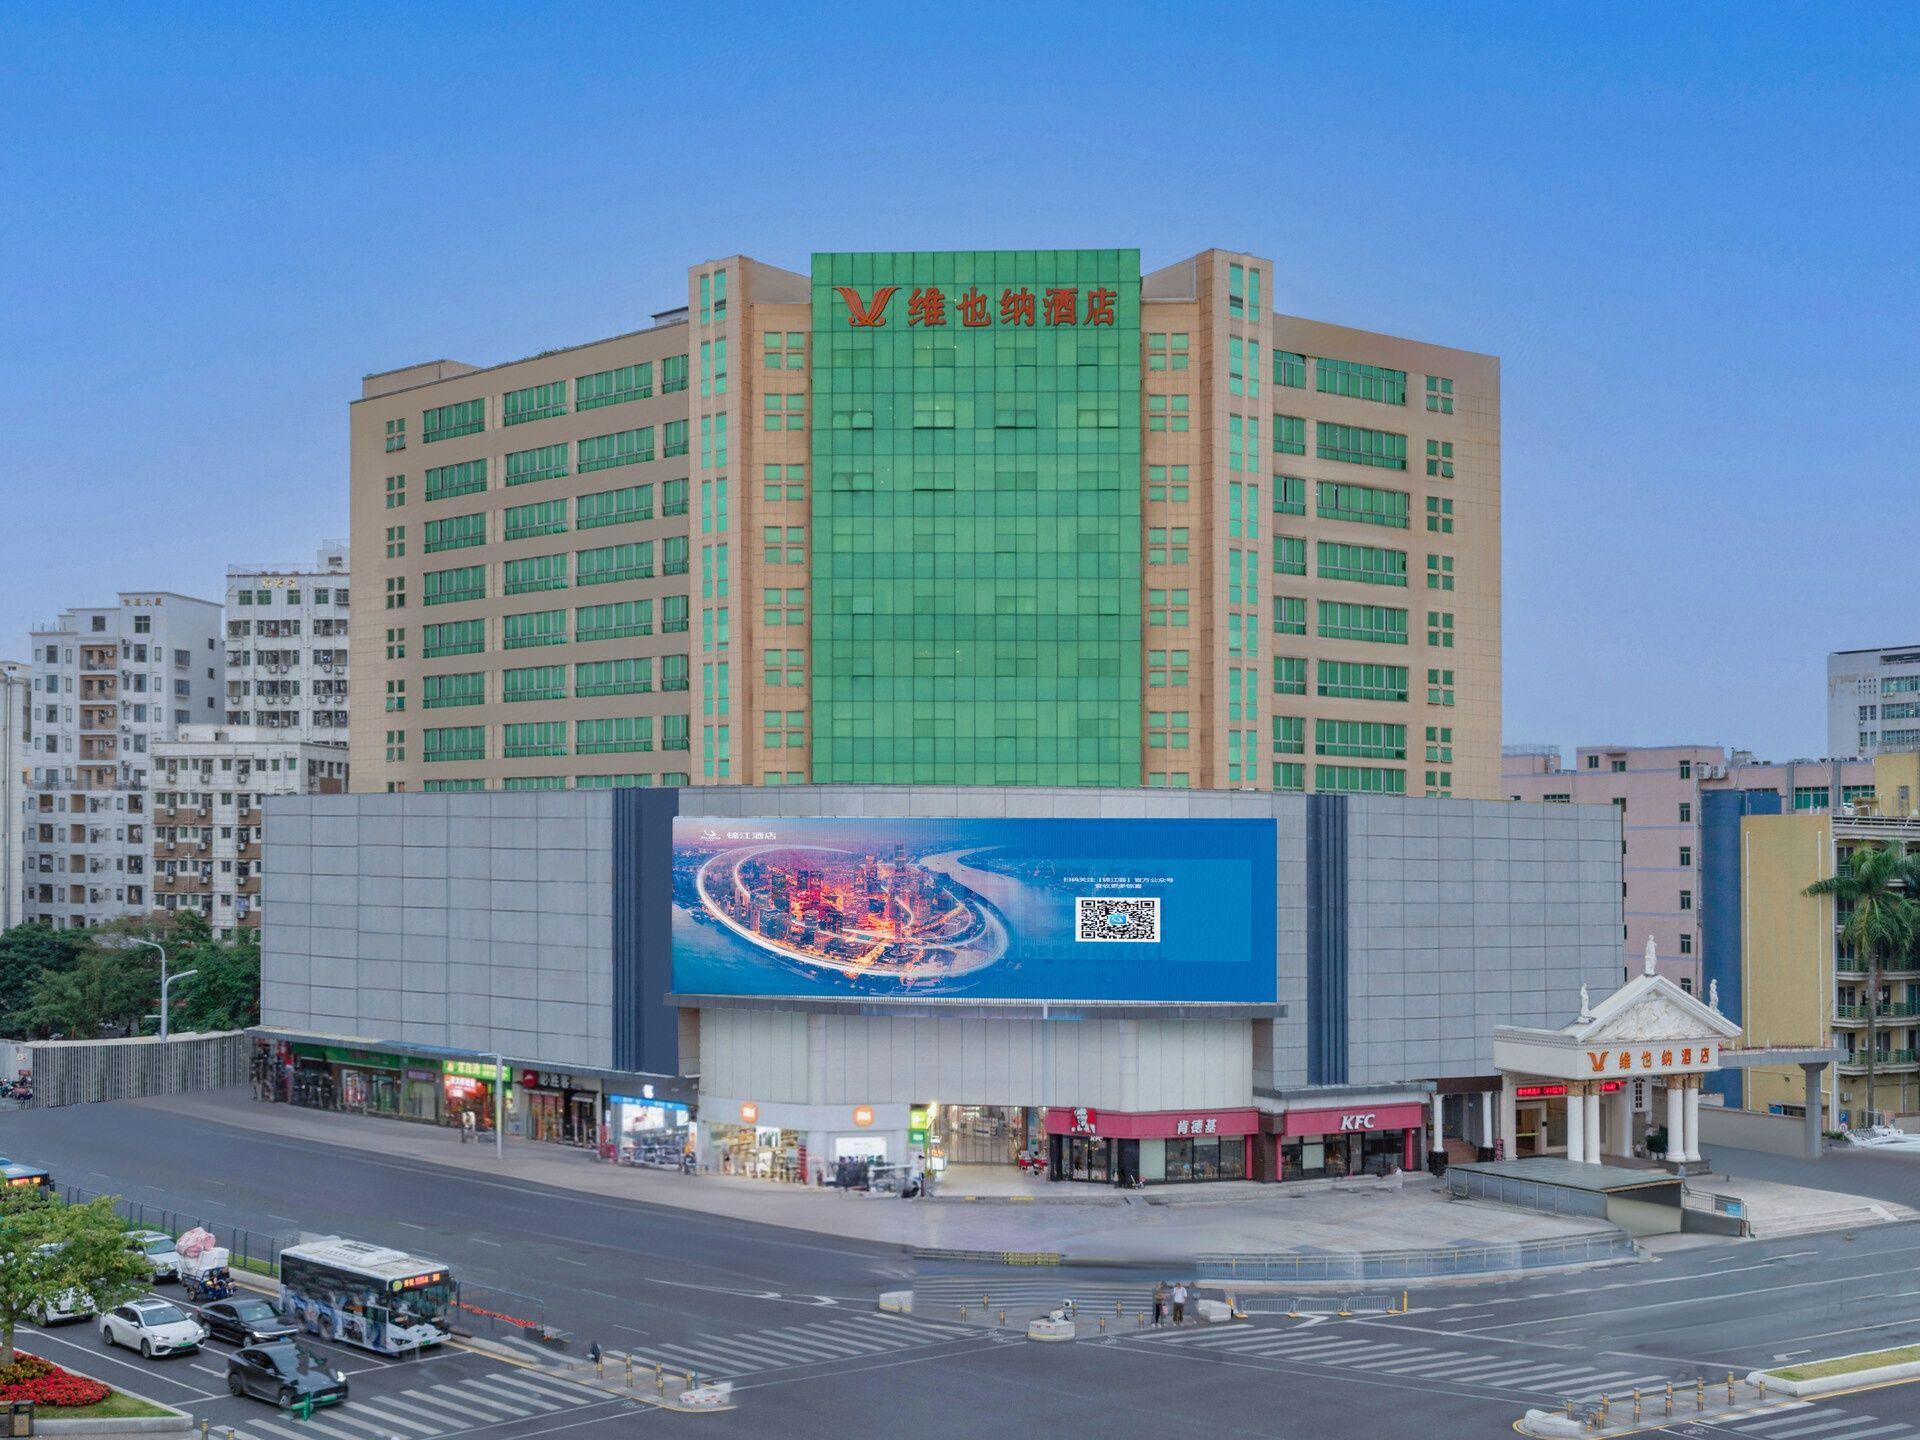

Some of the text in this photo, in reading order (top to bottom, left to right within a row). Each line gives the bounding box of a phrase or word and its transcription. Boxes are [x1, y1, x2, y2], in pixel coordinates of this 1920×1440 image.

[907, 286, 1118, 327] 维也纳酒店
[726, 831, 777, 840] 锦江酒店
[1618, 1047, 1710, 1070] 维也纳酒店
[539, 1072, 570, 1089] 必胜客
[1177, 1118, 1217, 1135] 肯德基
[1340, 1113, 1376, 1131] KFC
